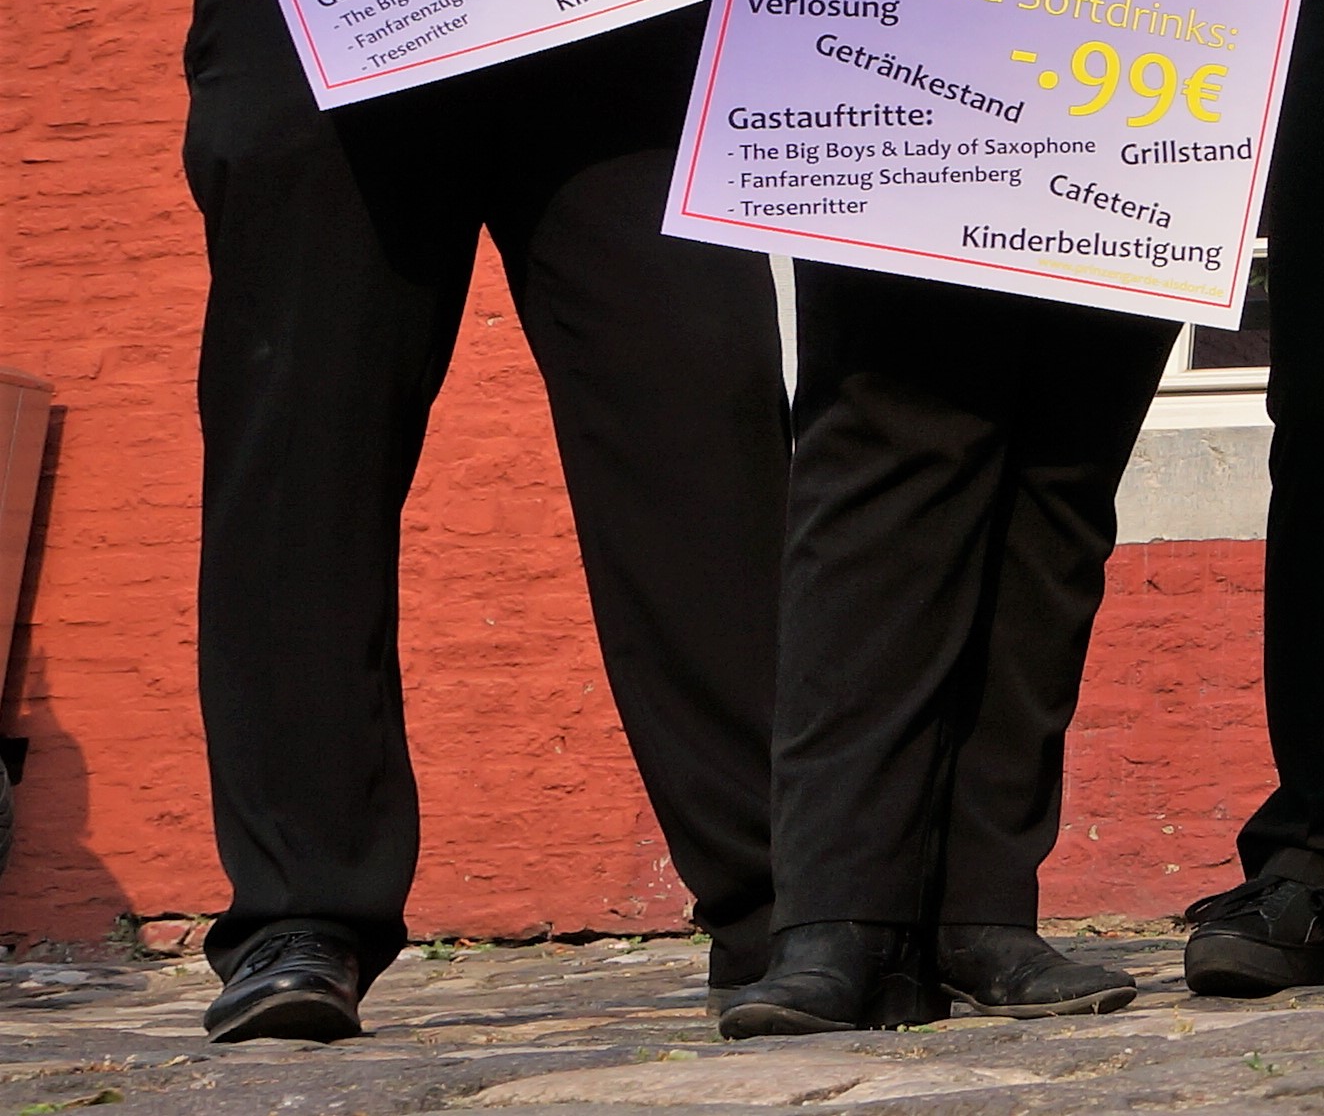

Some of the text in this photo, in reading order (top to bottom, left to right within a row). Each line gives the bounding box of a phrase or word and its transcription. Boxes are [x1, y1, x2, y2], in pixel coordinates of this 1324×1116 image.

[340, 7, 376, 26] The
[367, 14, 467, 67] Tresenritter
[816, 34, 1024, 123] Getränkestand
[1010, 41, 1229, 128] -.99€
[728, 103, 932, 129] Gastauftritte:
[739, 143, 779, 160] The
[786, 143, 819, 164] Big
[827, 143, 875, 162] Boys
[882, 141, 897, 157] &
[905, 139, 951, 160] Lady
[958, 138, 979, 155] of
[985, 137, 1095, 158] Saxophone
[1121, 137, 1252, 165] Grillstand
[741, 170, 873, 190] Fanfarenzug
[880, 166, 1022, 187] Schaufenberg
[740, 198, 867, 216] Tresenritter
[1050, 175, 1170, 228] Cafeteria
[963, 226, 1223, 271] Kinderbelustigung
